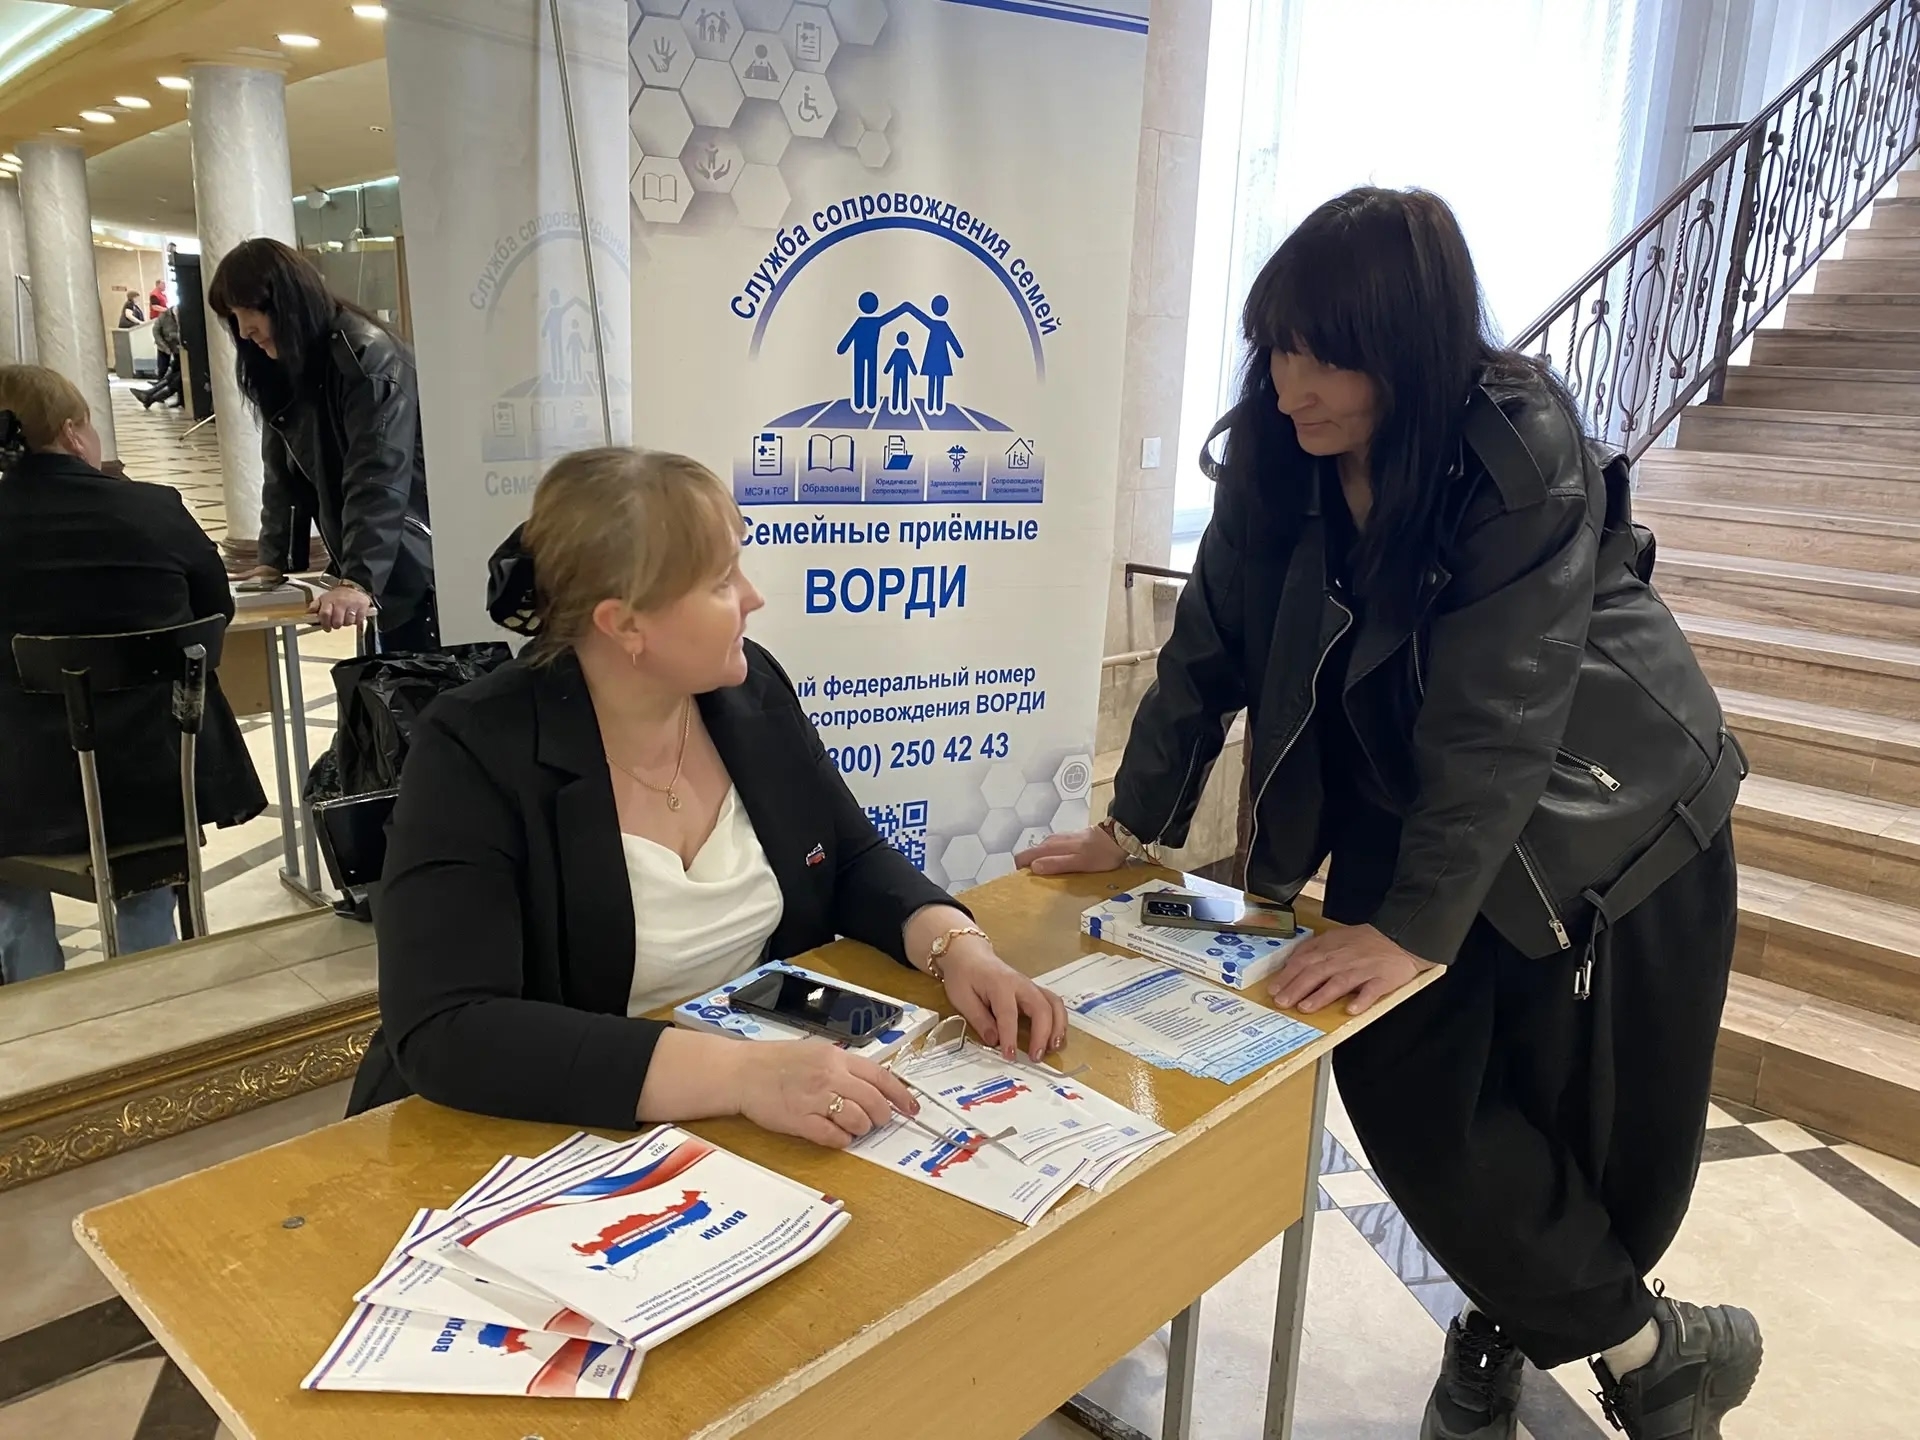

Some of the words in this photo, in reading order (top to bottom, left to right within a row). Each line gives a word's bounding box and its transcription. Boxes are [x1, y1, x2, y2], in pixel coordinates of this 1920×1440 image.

[470, 236, 518, 310] Служба
[730, 228, 811, 319] Служба
[812, 192, 1011, 259] сопровождения
[1009, 258, 1062, 335] семей
[744, 487, 762, 497] МСЭ
[771, 486, 789, 496] ТСР
[802, 483, 860, 494] Образование
[741, 514, 890, 546] Семейные
[899, 513, 1038, 549] приёмные
[806, 565, 967, 619] ВОРДИ
[823, 667, 969, 700] федеральный
[975, 667, 1036, 687] номер
[809, 700, 970, 729] сопровождения
[976, 691, 1045, 714] ВОРДИ
[890, 739, 935, 769] 250
[943, 735, 972, 762] 42
[980, 732, 1009, 759] 43
[651, 1142, 668, 1156] 2023
[897, 1149, 923, 1166] ВОРДИ
[699, 1210, 748, 1241] ВОРДИ
